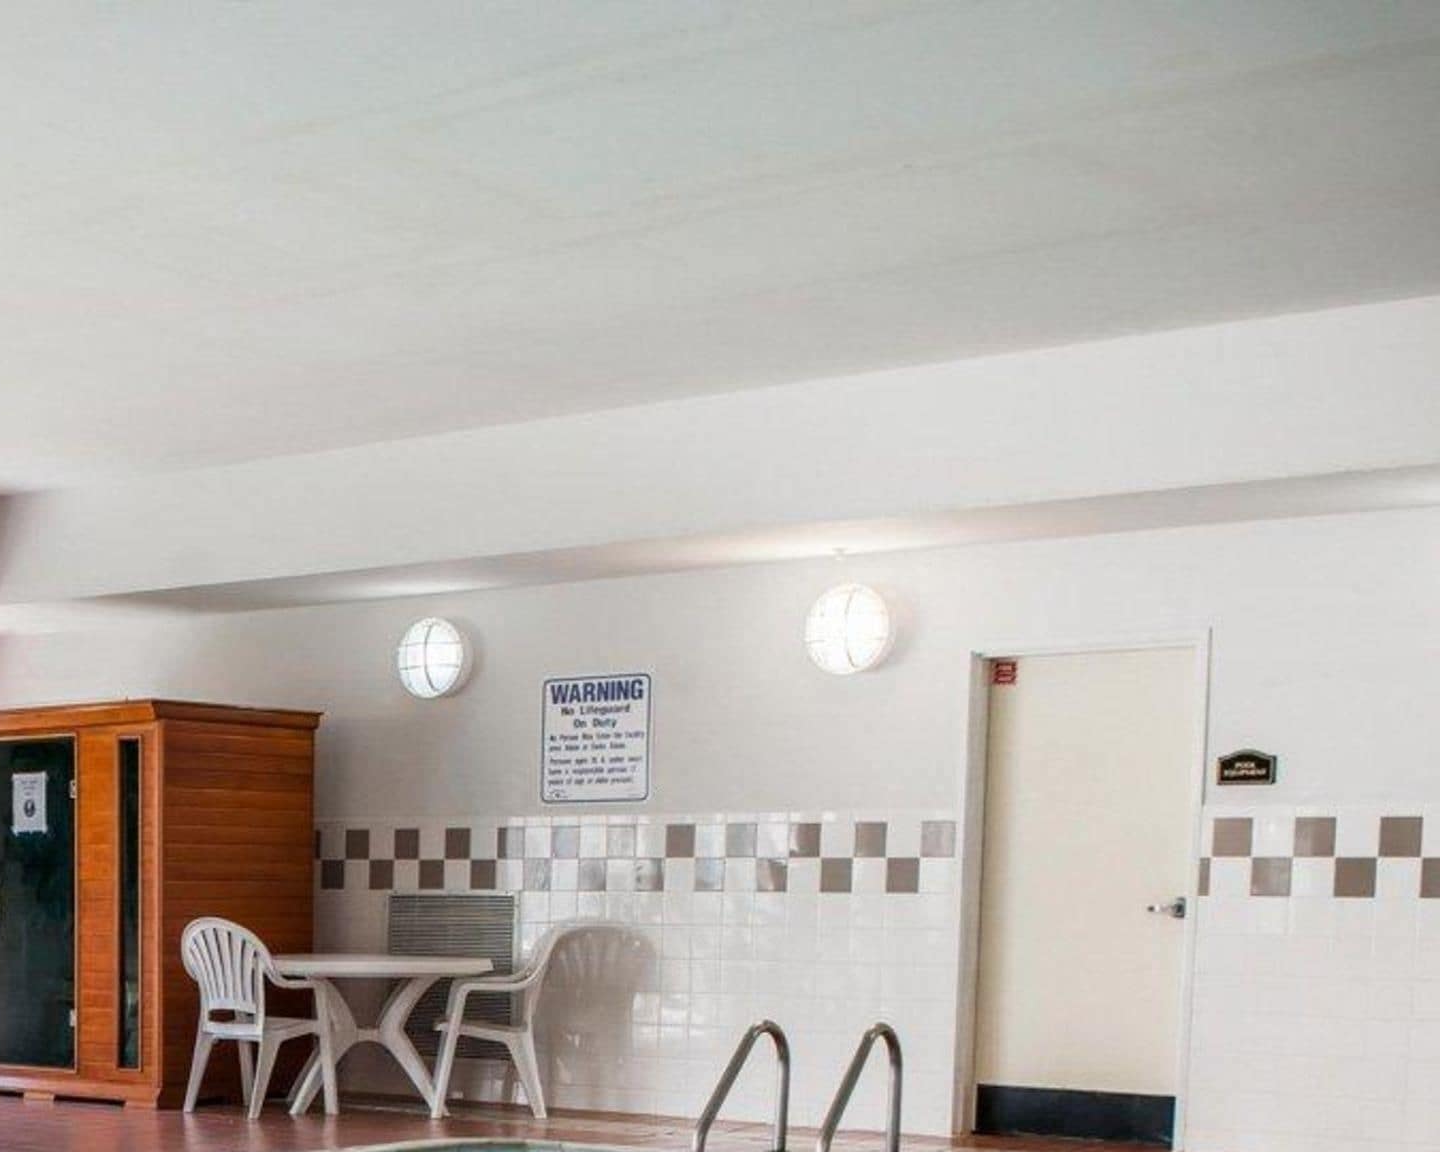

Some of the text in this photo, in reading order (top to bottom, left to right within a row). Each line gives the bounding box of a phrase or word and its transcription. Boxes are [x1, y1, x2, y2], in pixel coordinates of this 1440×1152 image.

[550, 679, 644, 705] WARNING
[561, 704, 630, 716] No Lifeguard
[573, 718, 617, 728] On Duty
